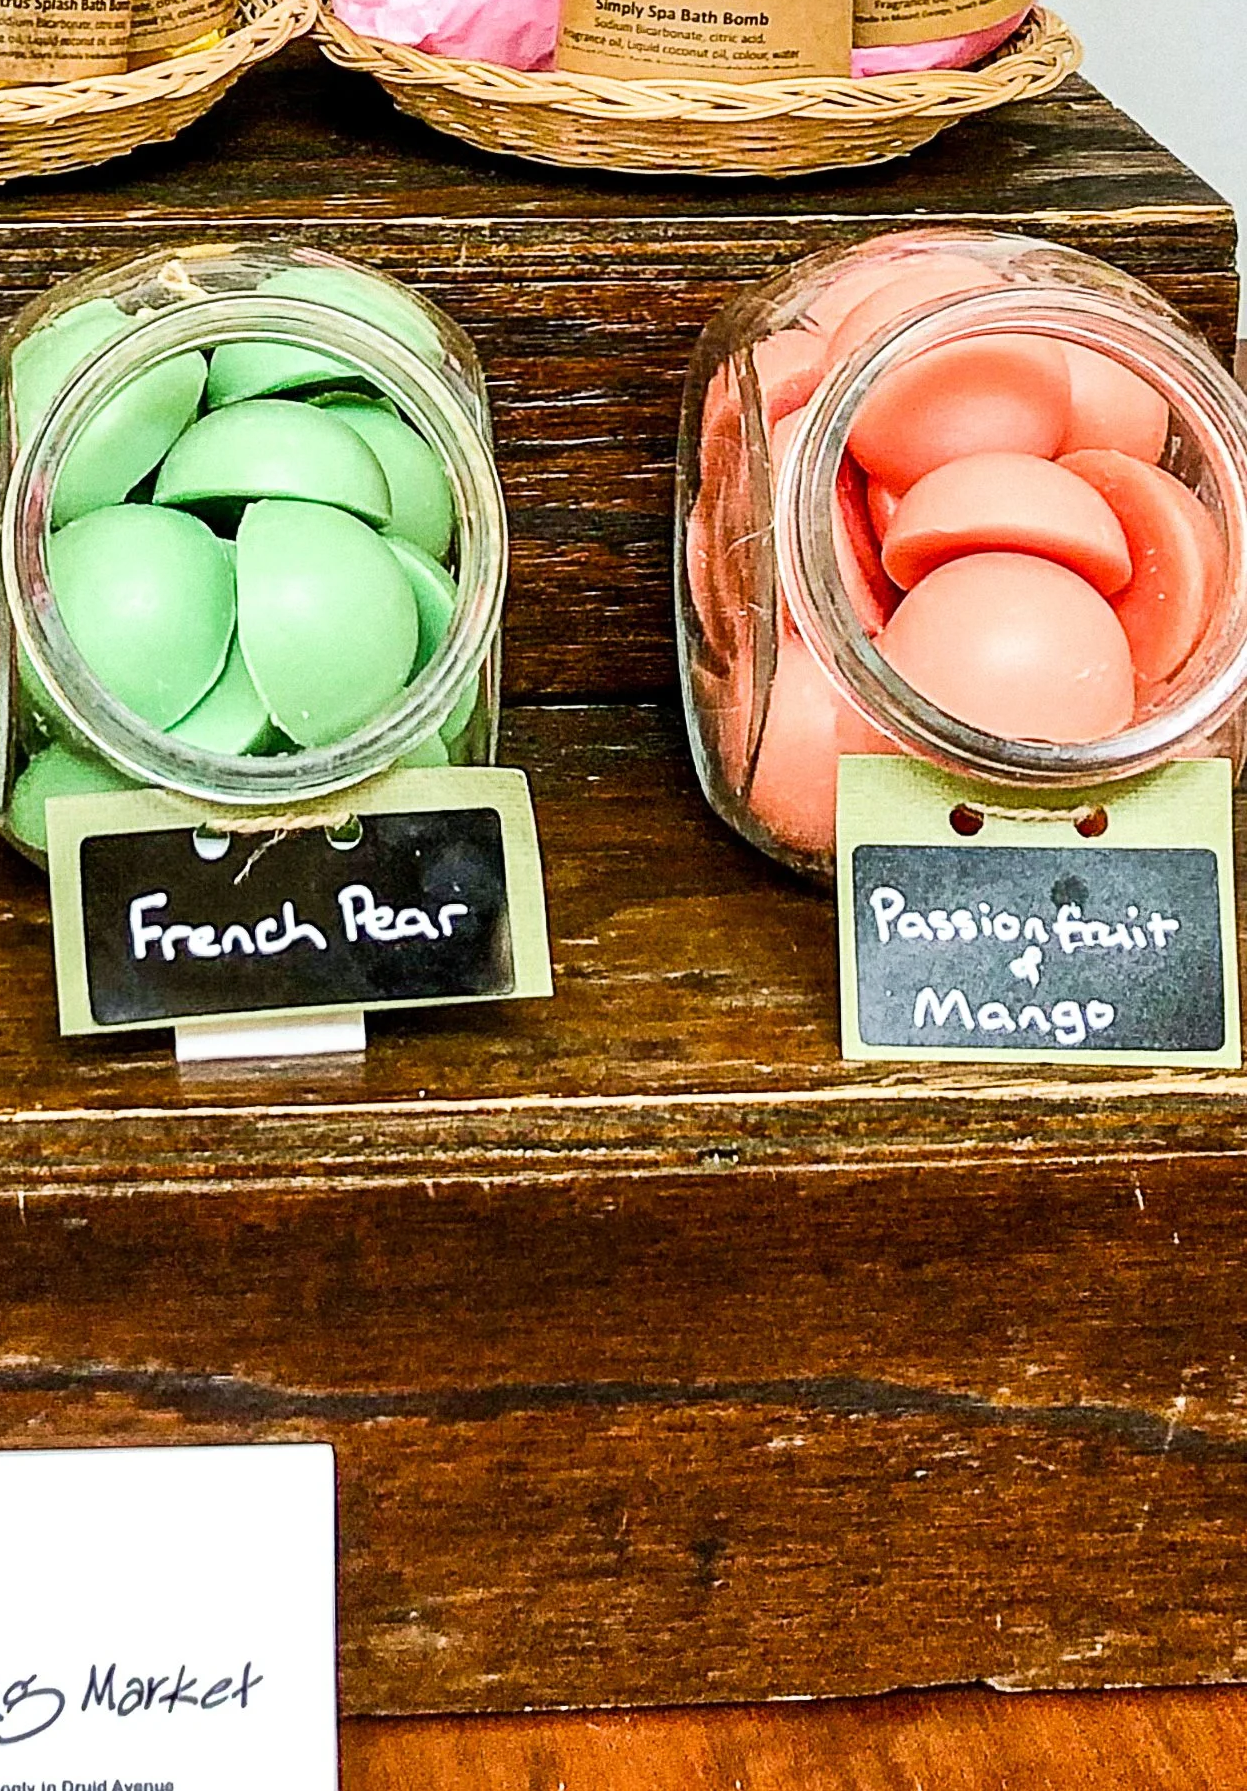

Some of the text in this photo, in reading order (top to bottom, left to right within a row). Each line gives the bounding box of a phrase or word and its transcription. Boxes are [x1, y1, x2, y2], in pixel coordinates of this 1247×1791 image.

[594, 17, 633, 33] Sodium
[709, 32, 738, 43] citric
[648, 5, 675, 20] Spa
[681, 8, 717, 25] Bath
[723, 12, 769, 26] Bomb
[627, 40, 660, 55] Liquid
[663, 46, 708, 58] coconut
[128, 883, 469, 962] French Pear
[912, 986, 1115, 1045] Mango
[81, 1660, 264, 1717] Market
